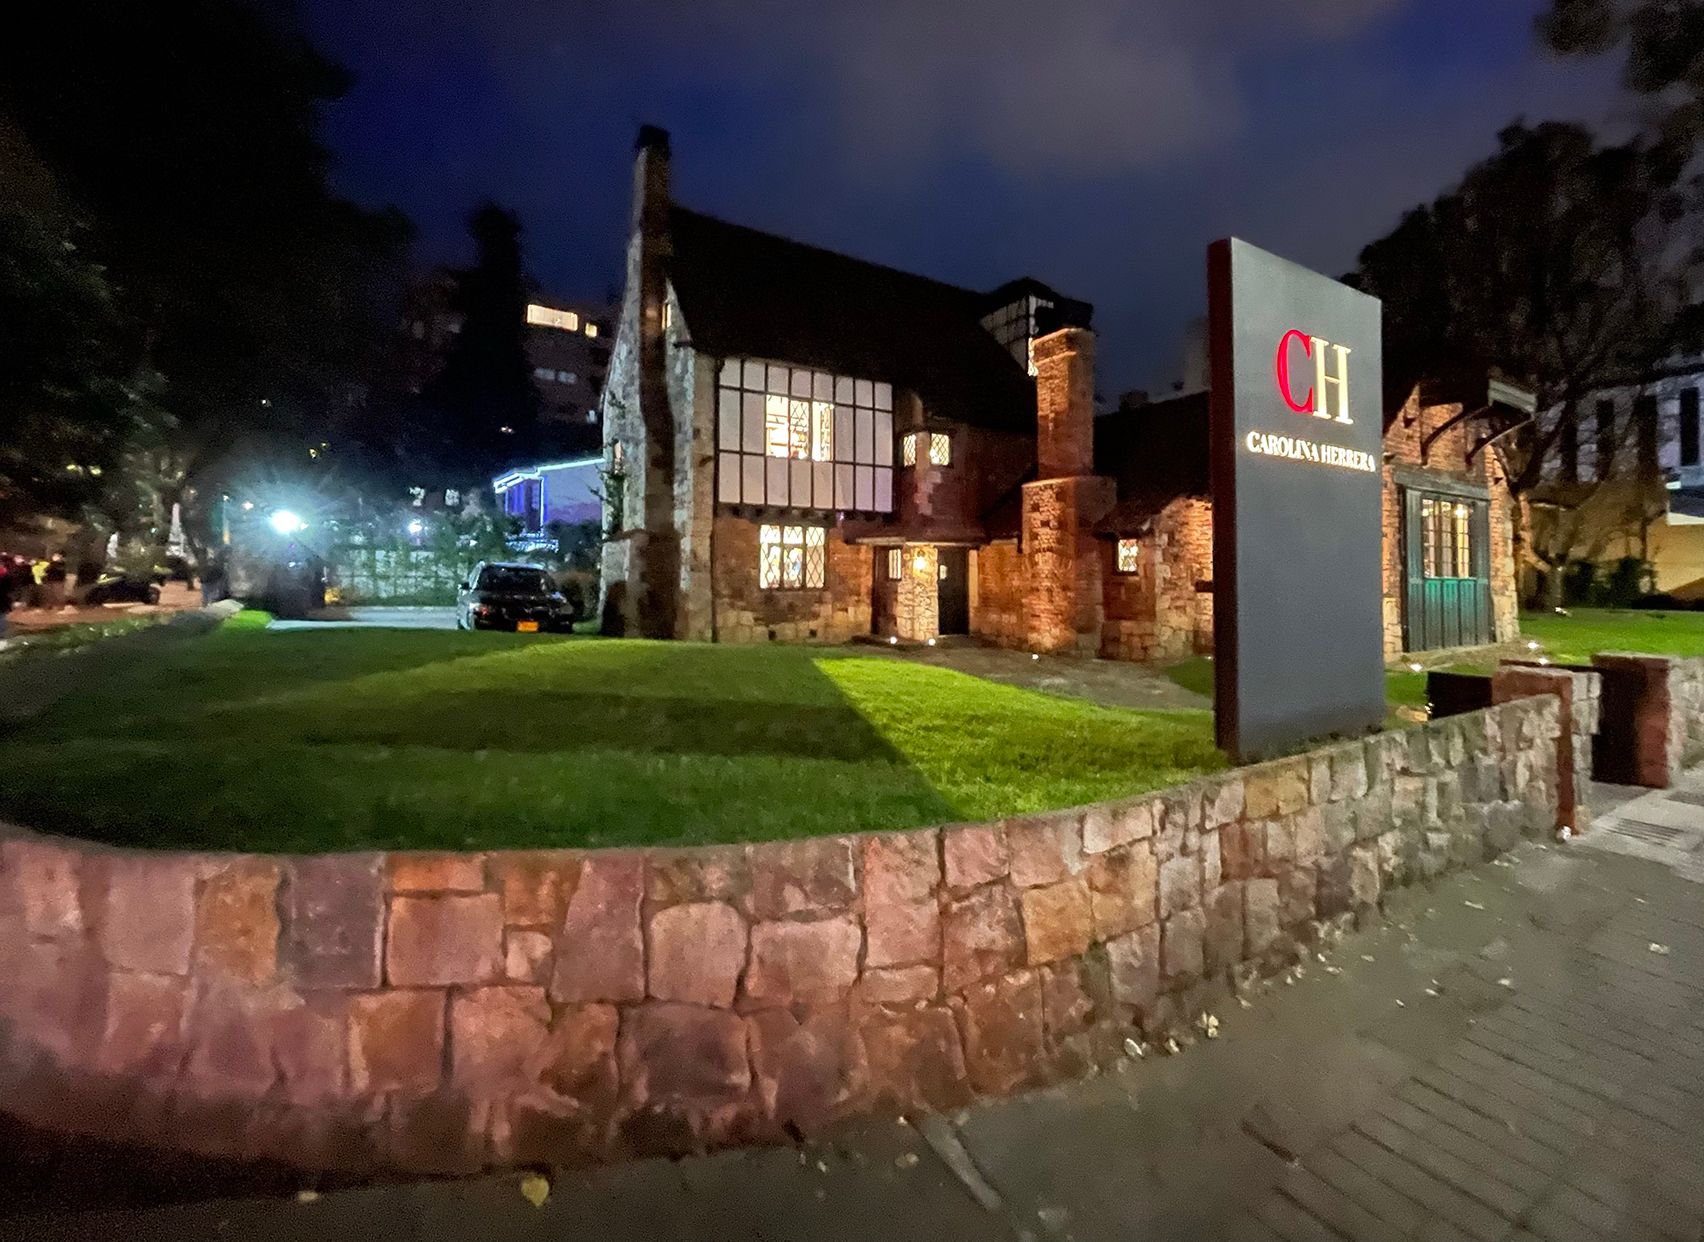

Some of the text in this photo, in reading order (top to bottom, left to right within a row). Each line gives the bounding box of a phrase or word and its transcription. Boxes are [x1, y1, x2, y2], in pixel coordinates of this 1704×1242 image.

[1276, 329, 1354, 424] CH
[1246, 431, 1376, 472] CAROLINA HERRERA
